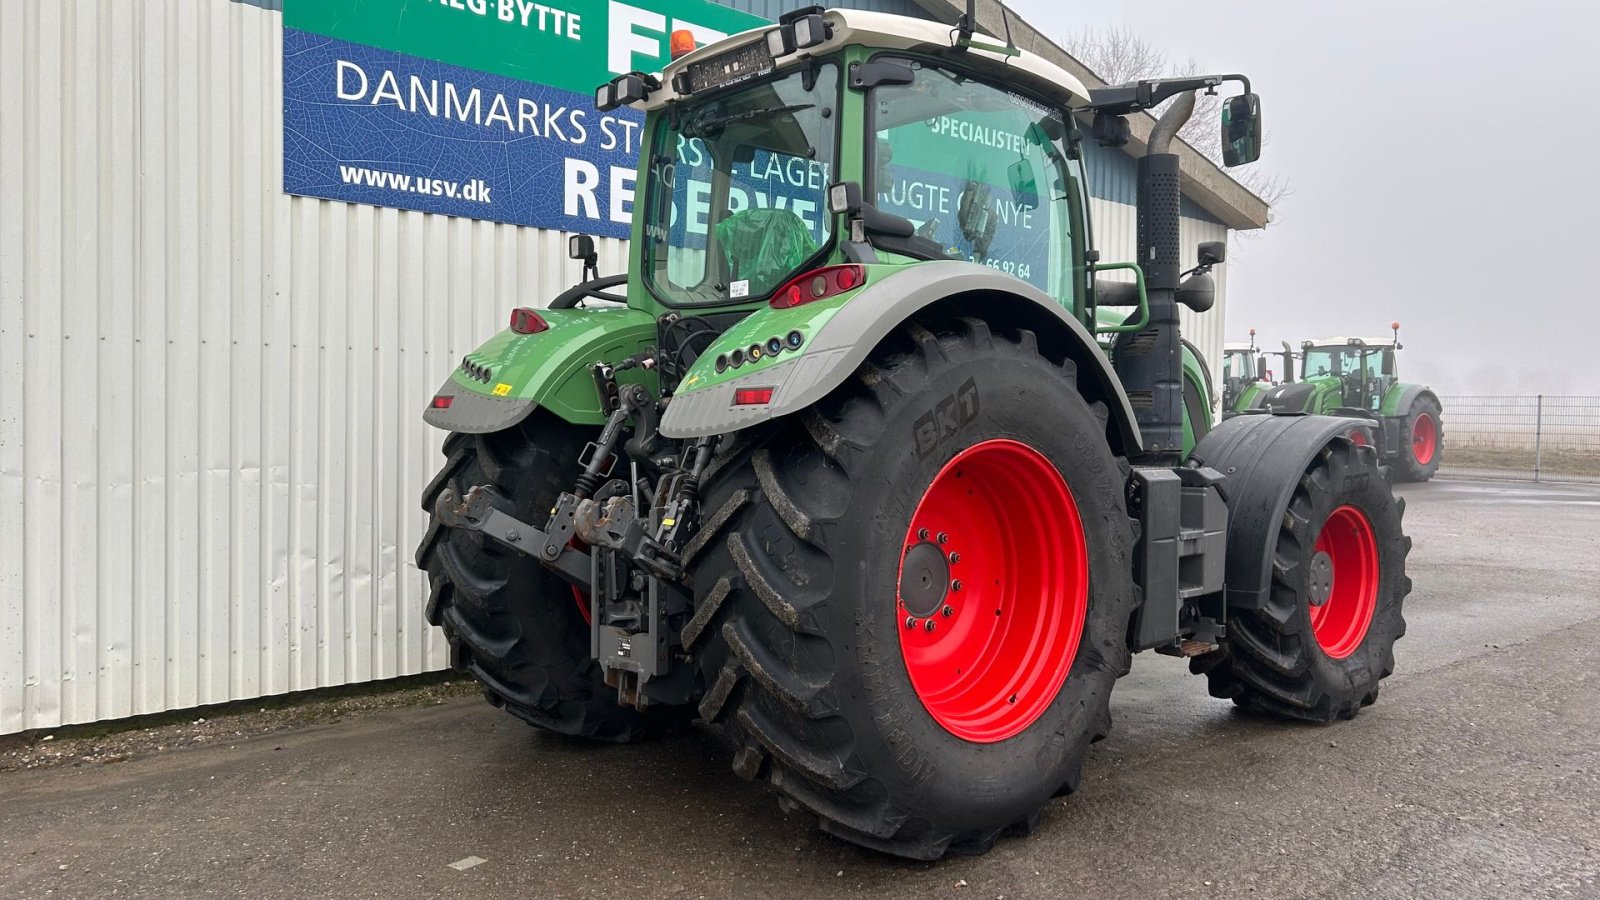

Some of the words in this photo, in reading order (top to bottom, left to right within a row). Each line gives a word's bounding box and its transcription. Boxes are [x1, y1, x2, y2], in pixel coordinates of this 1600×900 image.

[336, 60, 587, 145] DANMARKS
[340, 165, 491, 204] www.usv.dk
[877, 179, 950, 214] UGTE
[996, 198, 1033, 230] NYE
[1003, 261, 1015, 276] 92
[1018, 263, 1031, 279] 64
[913, 376, 980, 460] BKT
